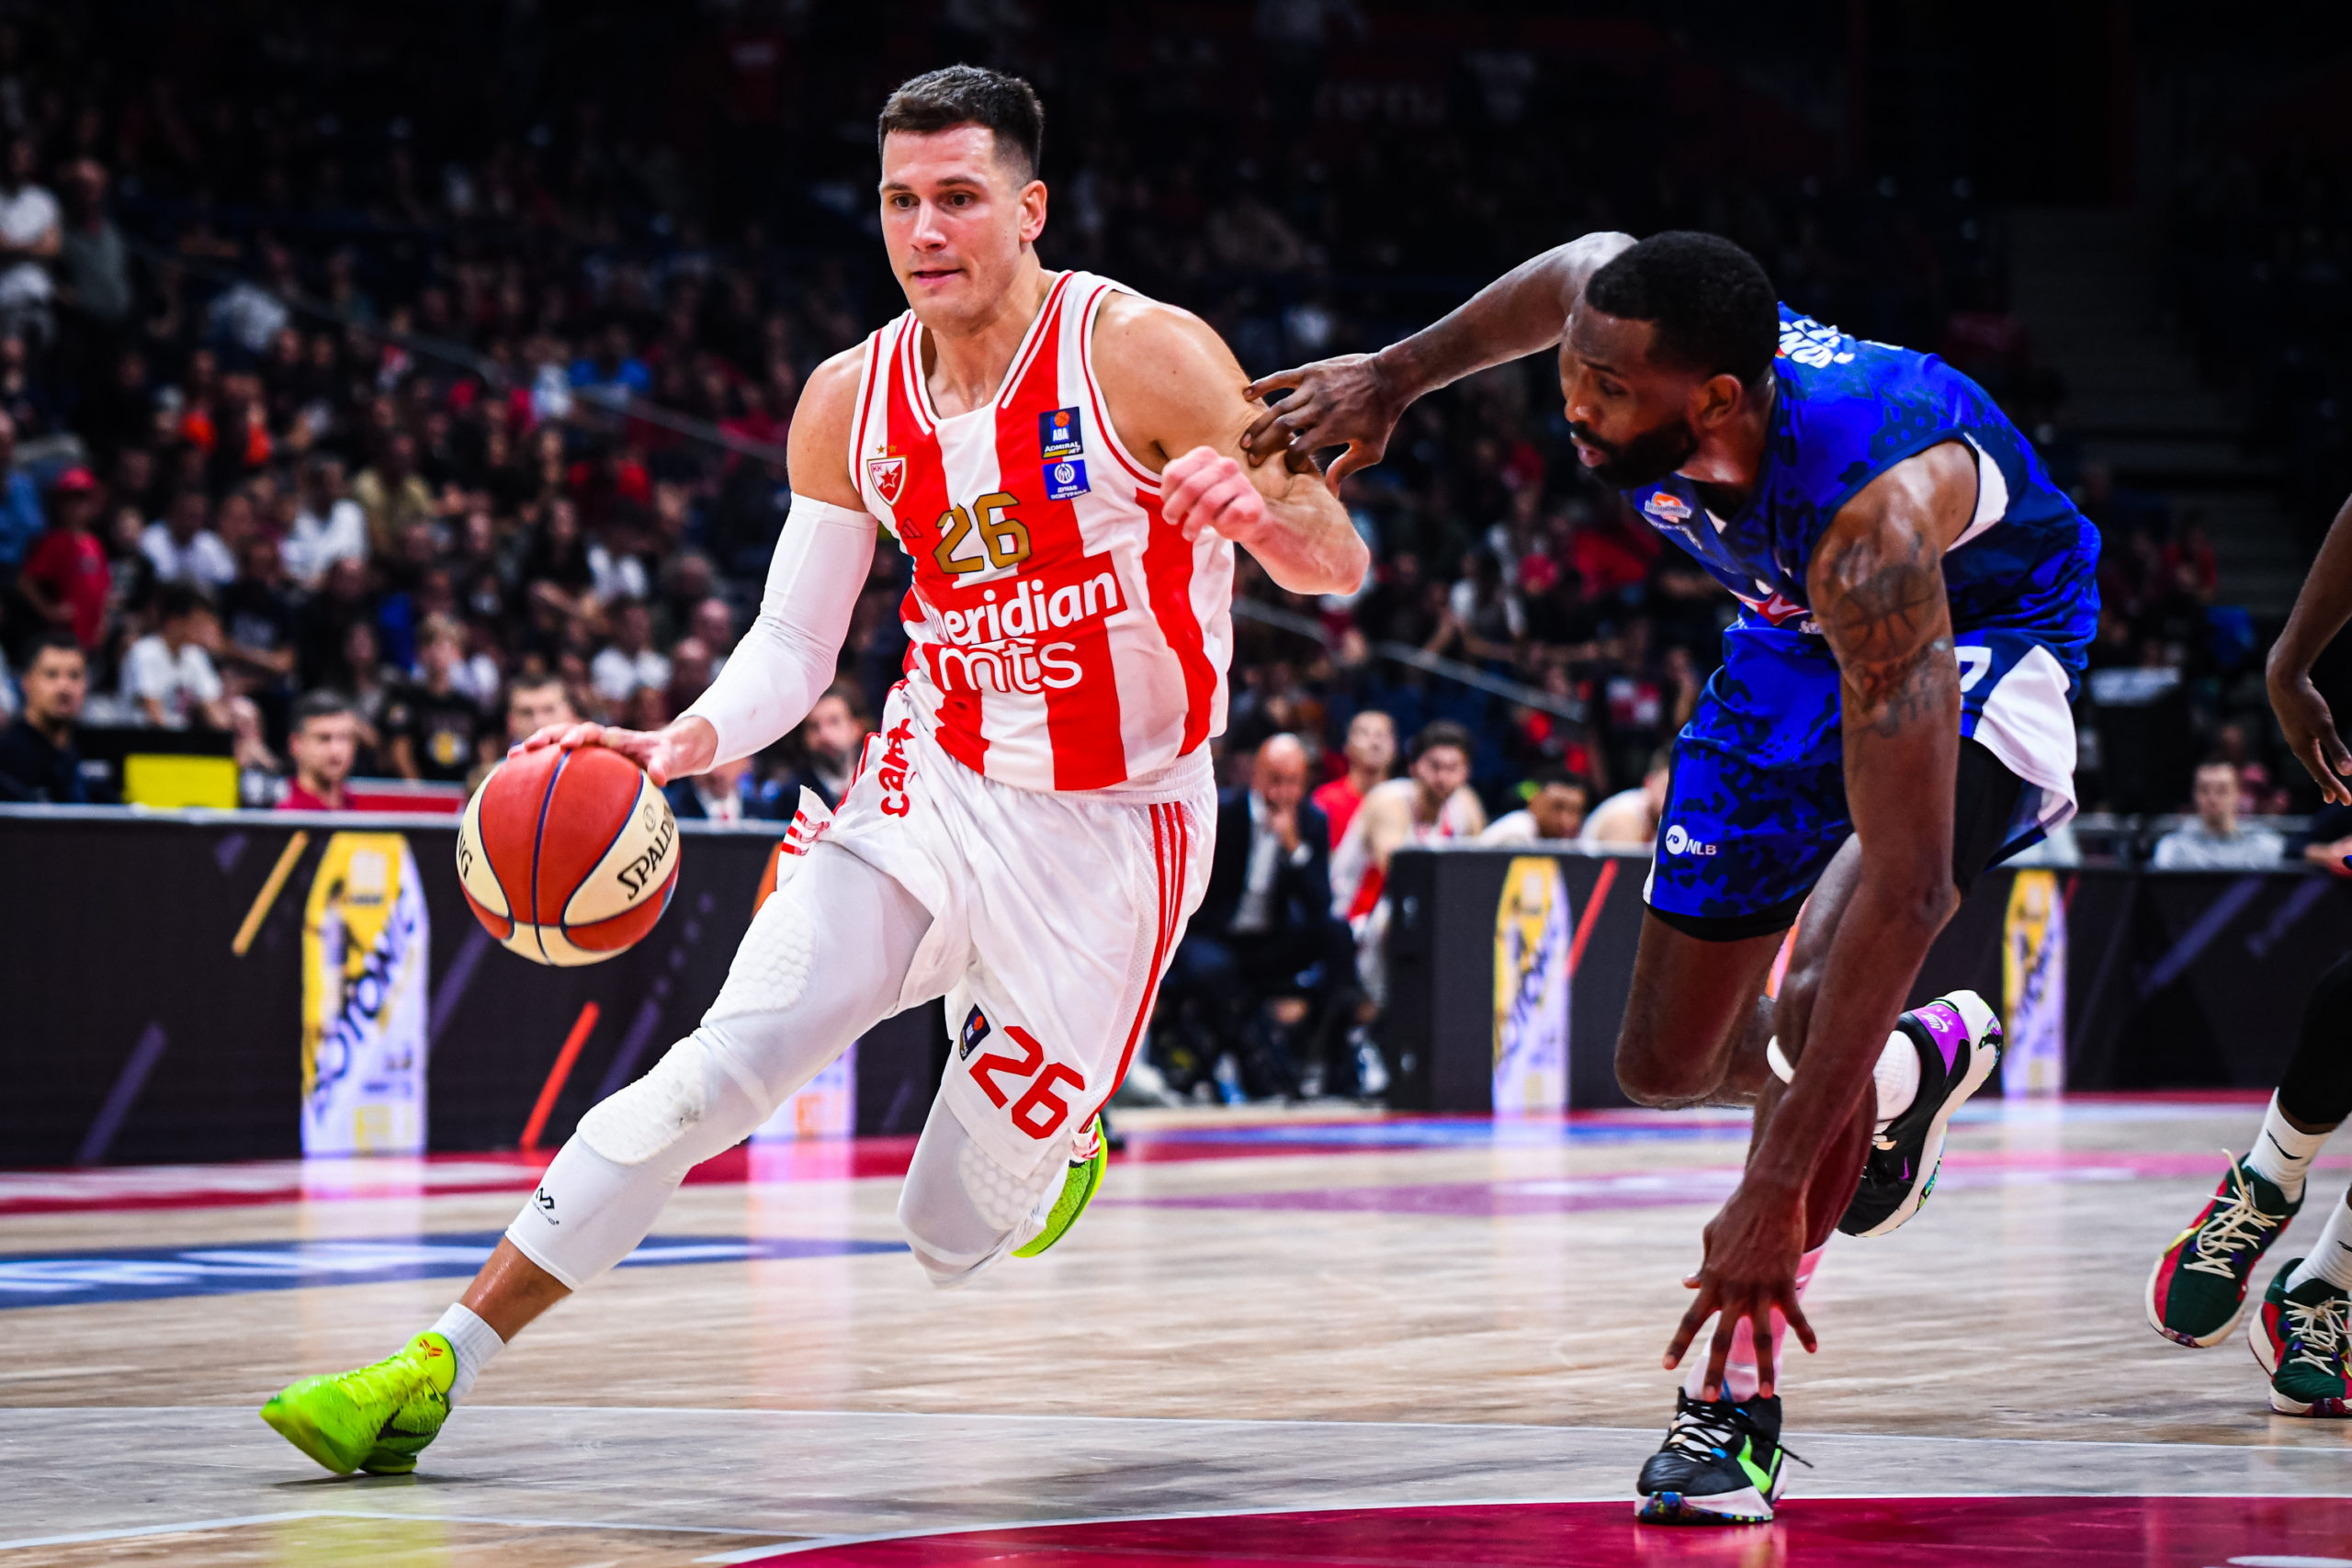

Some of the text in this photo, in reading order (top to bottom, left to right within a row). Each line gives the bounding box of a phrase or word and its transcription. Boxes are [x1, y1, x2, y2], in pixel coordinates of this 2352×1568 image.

[1045, 442, 1080, 452] ADMIRAL
[1053, 428, 1069, 441] ABA
[933, 491, 1033, 574] 26
[938, 640, 1083, 692] mts
[616, 820, 674, 902] SPALD
[1685, 838, 1717, 855] NLB
[968, 1025, 1086, 1140] 26
